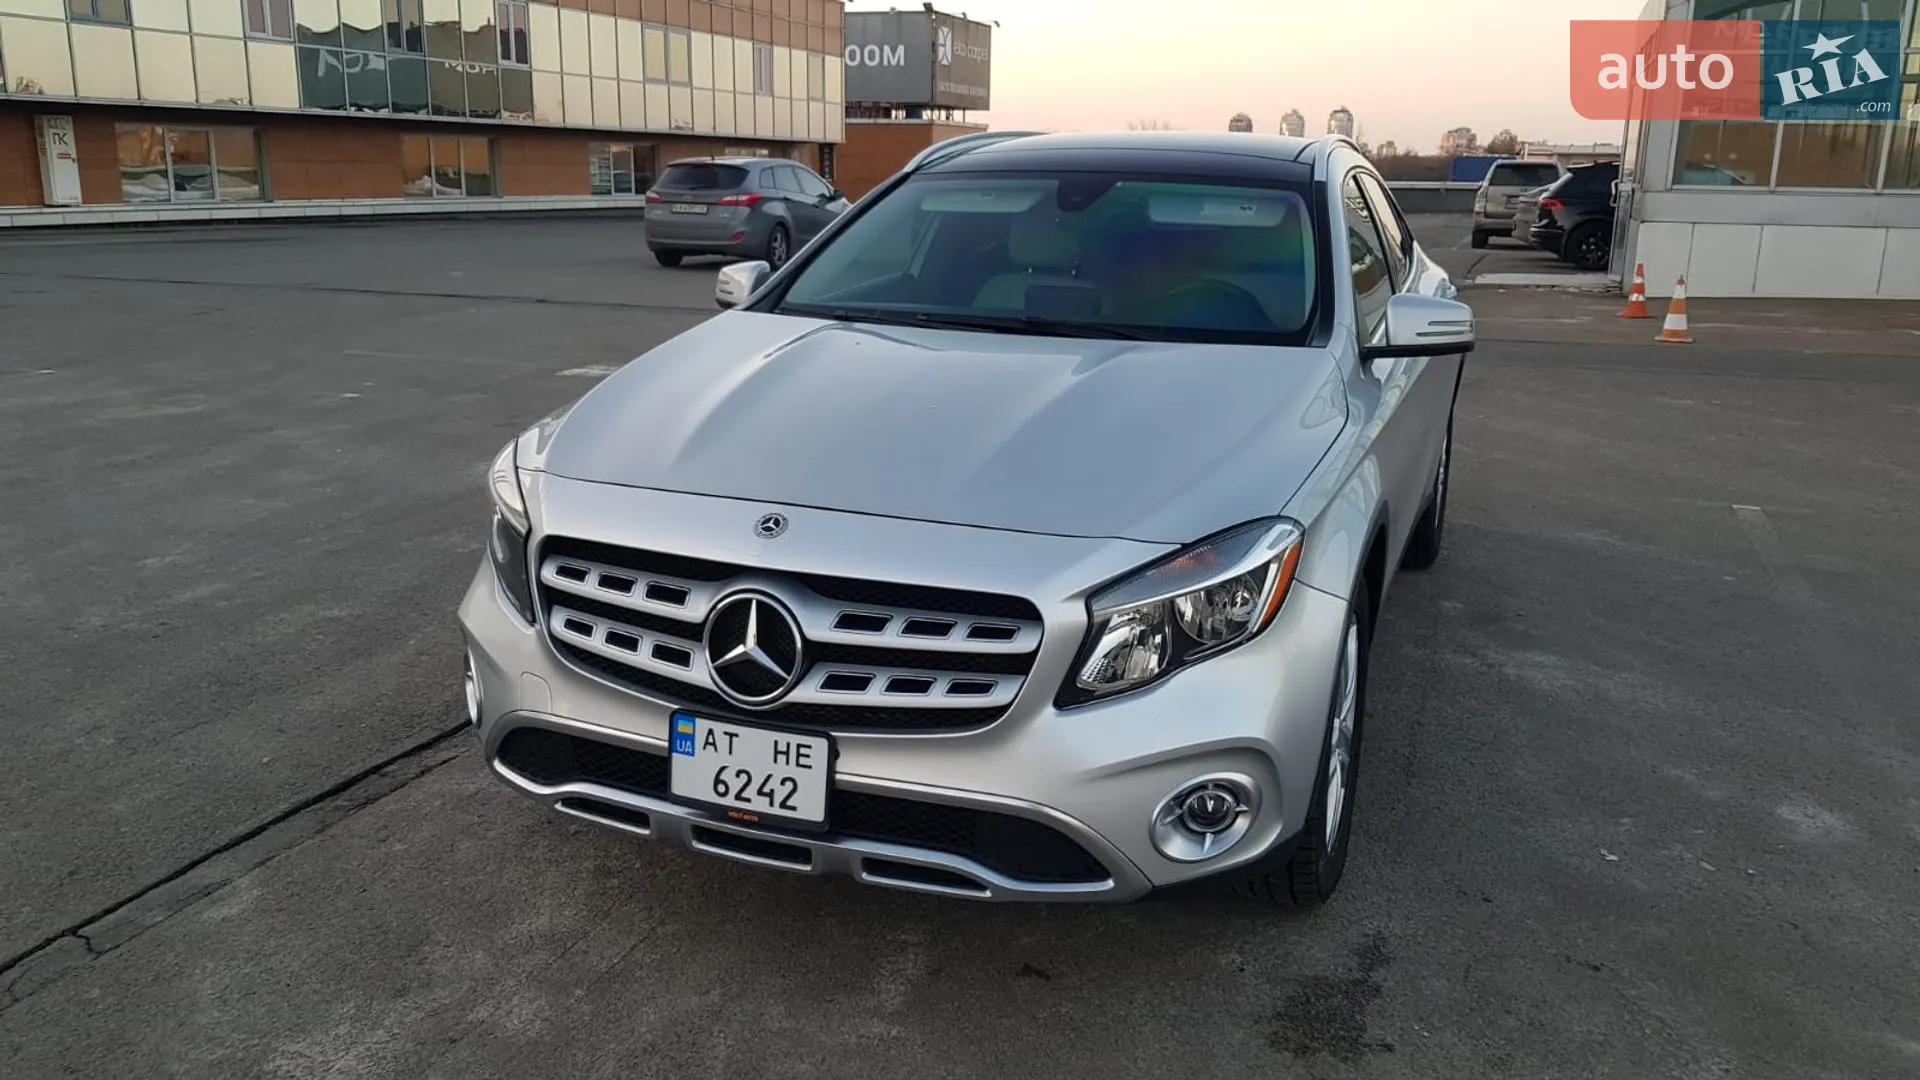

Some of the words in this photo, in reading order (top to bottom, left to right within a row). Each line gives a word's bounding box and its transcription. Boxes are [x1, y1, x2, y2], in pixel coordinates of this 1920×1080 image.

[676, 739, 693, 754] UA
[703, 728, 739, 756] AT
[773, 740, 813, 769] HE
[713, 765, 798, 811] 6242
